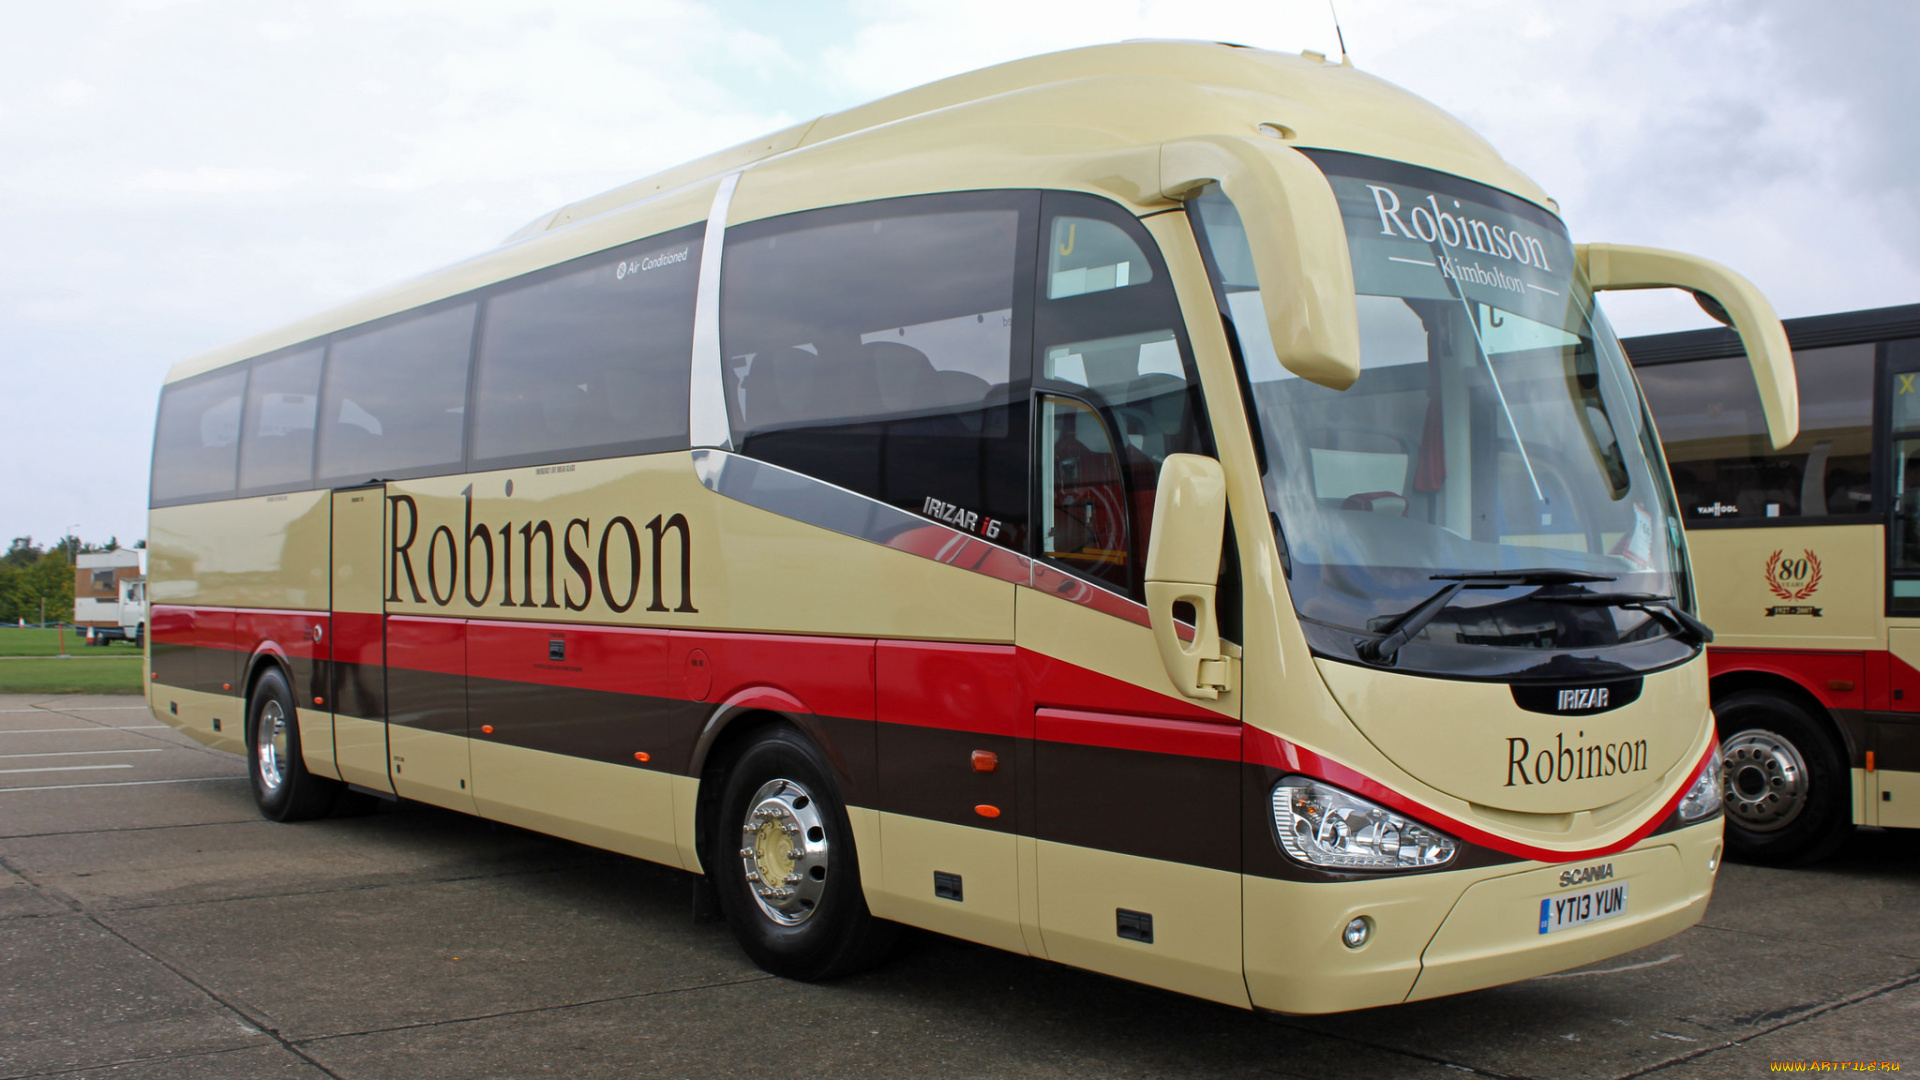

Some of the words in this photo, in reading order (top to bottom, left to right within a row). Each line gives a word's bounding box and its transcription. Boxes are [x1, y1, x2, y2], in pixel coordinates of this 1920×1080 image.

[1366, 184, 1552, 272] Robinson
[627, 261, 640, 275] Air
[641, 246, 689, 271] Conditioned
[1438, 254, 1525, 293] Kimbolton
[1899, 374, 1916, 394] X
[922, 496, 978, 532] IRIZAR
[981, 516, 1002, 539] i6
[386, 482, 699, 614] Robinson
[1779, 558, 1808, 581] 80
[1558, 687, 1609, 710] IRIZAR
[1503, 730, 1648, 787] Robinson
[1559, 863, 1613, 887] SCANIA
[1556, 893, 1591, 925] YT13
[1595, 886, 1623, 916] YUN
